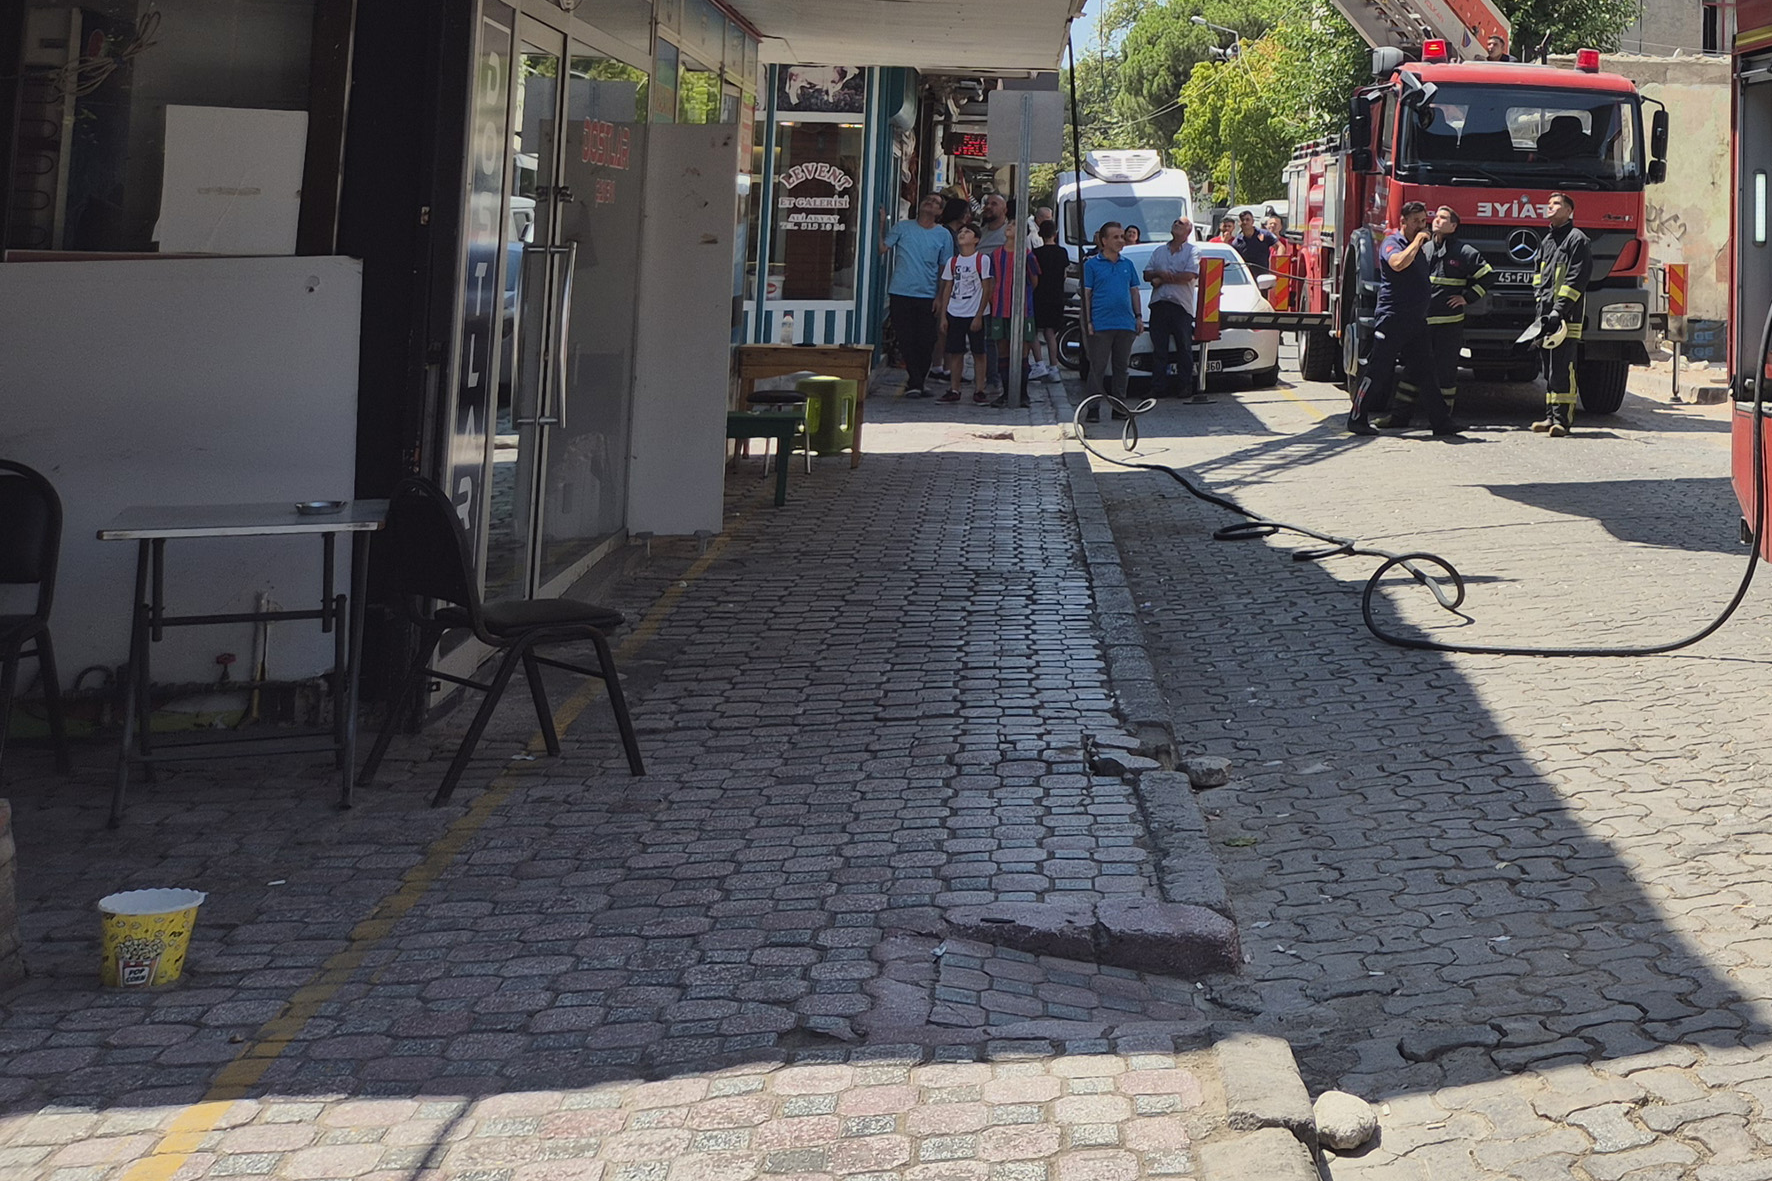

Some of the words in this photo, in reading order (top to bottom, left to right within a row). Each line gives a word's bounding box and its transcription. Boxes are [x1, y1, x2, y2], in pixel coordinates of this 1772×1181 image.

[581, 115, 631, 171] DOSTLAR
[780, 162, 853, 191] LEVENT
[778, 197, 795, 208] ET
[796, 195, 849, 208] GALERİSİ
[455, 51, 500, 531] DOSTLAR
[1498, 272, 1511, 283] 45
